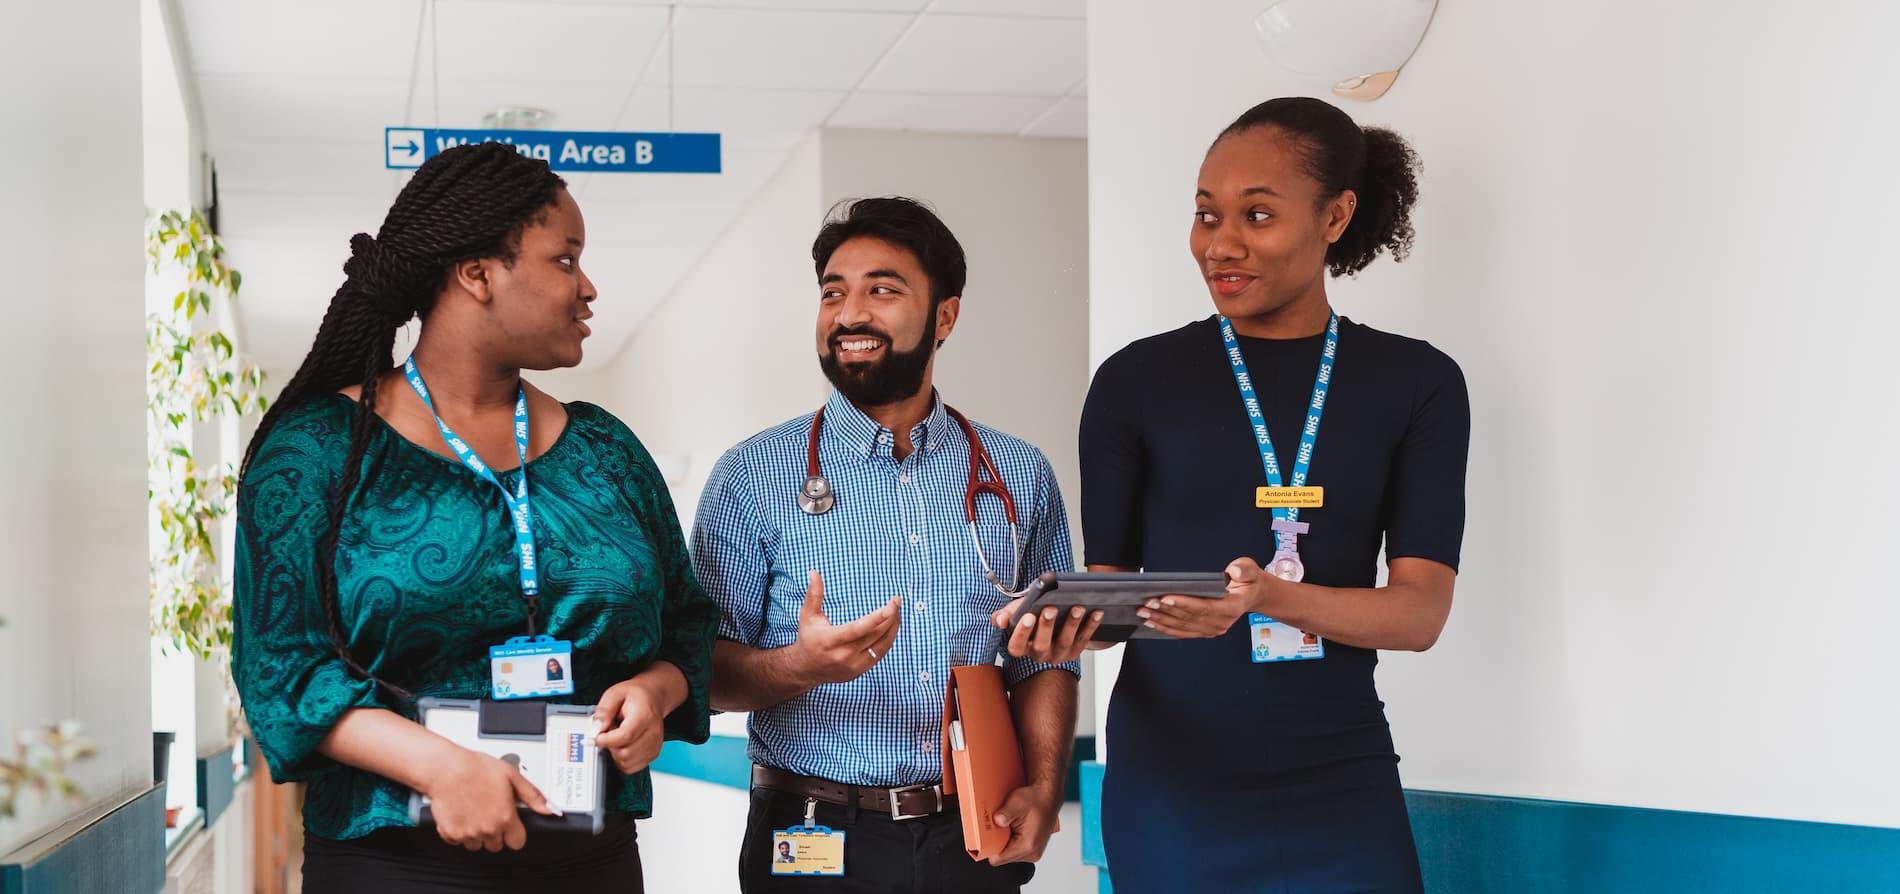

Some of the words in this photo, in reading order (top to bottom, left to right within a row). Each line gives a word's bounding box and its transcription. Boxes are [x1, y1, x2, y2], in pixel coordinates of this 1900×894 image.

[559, 139, 626, 164] Area
[635, 140, 653, 164] B
[1223, 325, 1234, 342] NHS
[1229, 347, 1243, 366] NHS
[1325, 338, 1336, 359] NHS
[1237, 372, 1252, 391] NHS
[1319, 363, 1331, 384] NHS
[1246, 398, 1260, 417] NHS
[1312, 389, 1325, 409] NHS
[516, 421, 527, 439] NHS
[1255, 424, 1270, 444] NHS
[1305, 415, 1319, 436] NHS
[1263, 452, 1278, 474] NHS
[1299, 442, 1312, 464] NHS
[1293, 472, 1304, 487] HS
[521, 543, 533, 570] NHS
